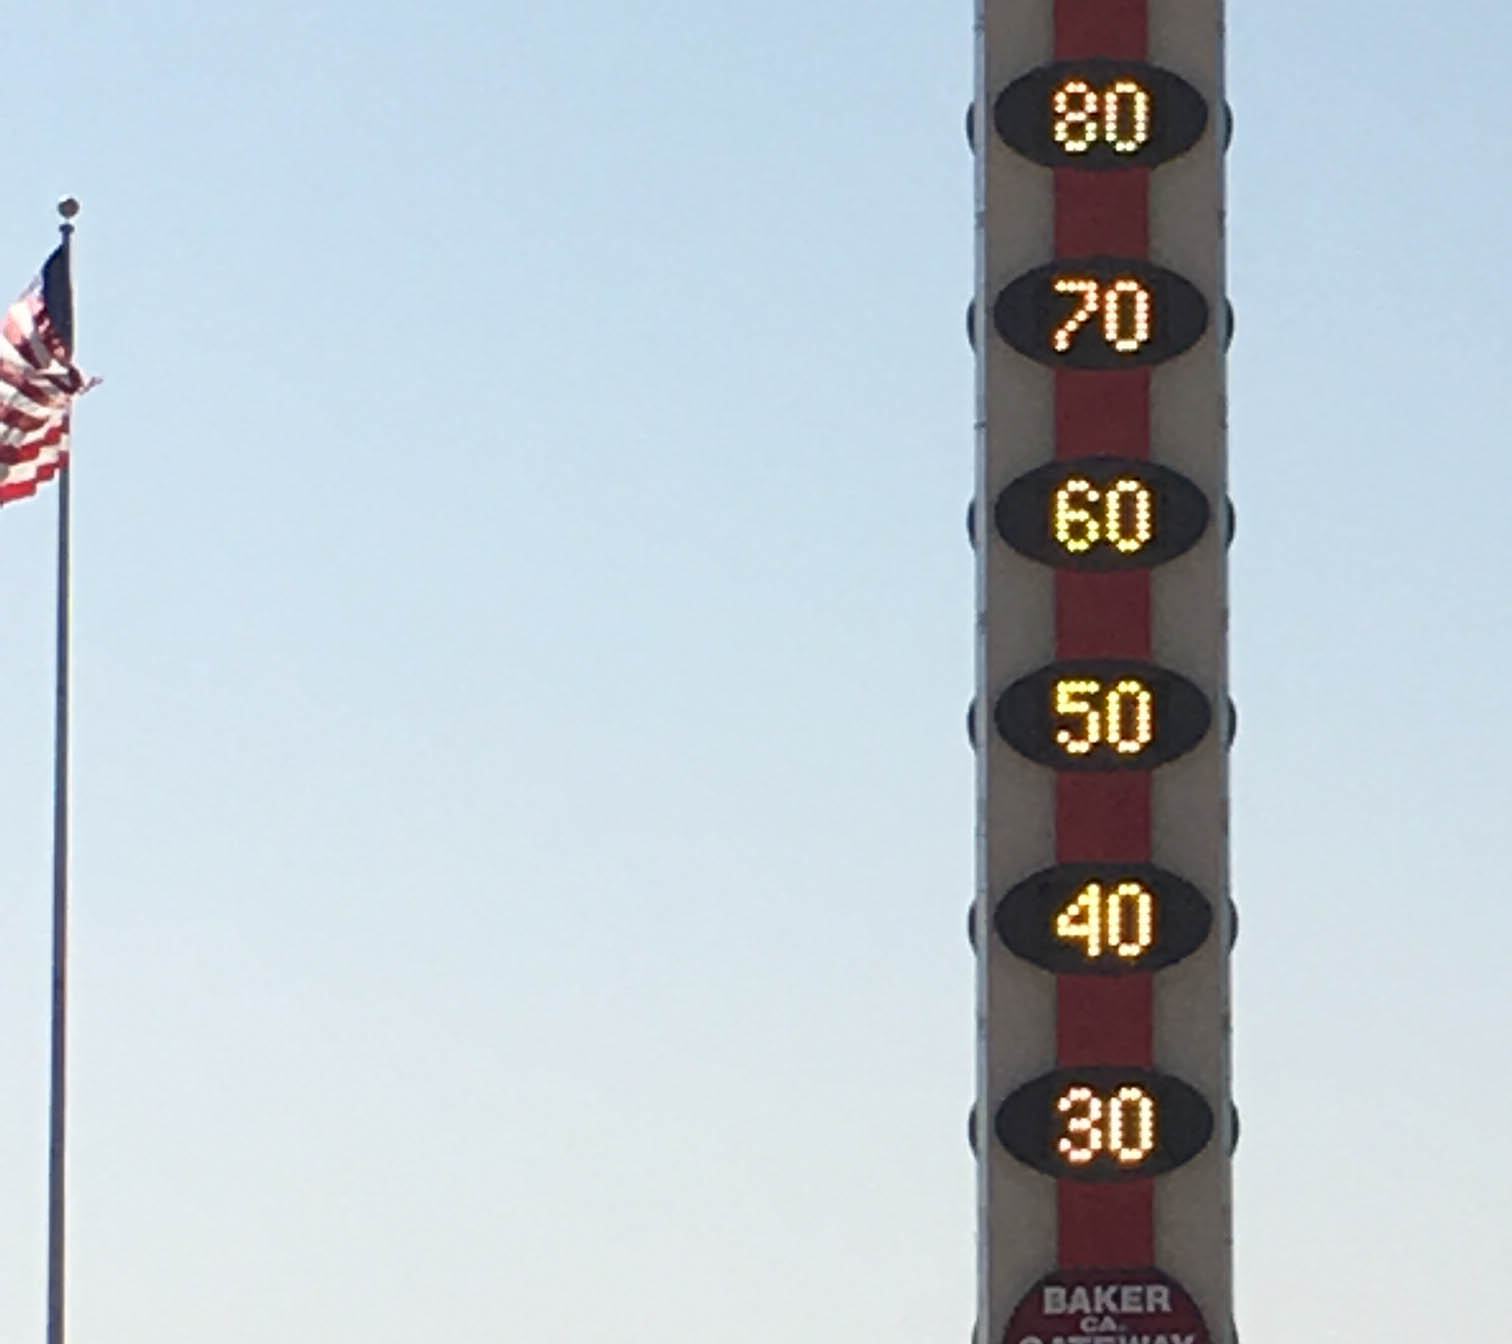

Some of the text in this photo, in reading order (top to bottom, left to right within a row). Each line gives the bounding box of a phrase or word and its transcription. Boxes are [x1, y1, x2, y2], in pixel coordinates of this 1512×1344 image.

[1053, 81, 1148, 151] 80
[1054, 279, 1150, 350] 70
[1055, 479, 1151, 553] 60
[1055, 680, 1151, 754] 50
[1056, 883, 1153, 957] 40
[1057, 1087, 1155, 1164] 30
[1043, 1285, 1172, 1314] BAKER
[1080, 1318, 1124, 1333] CA.
